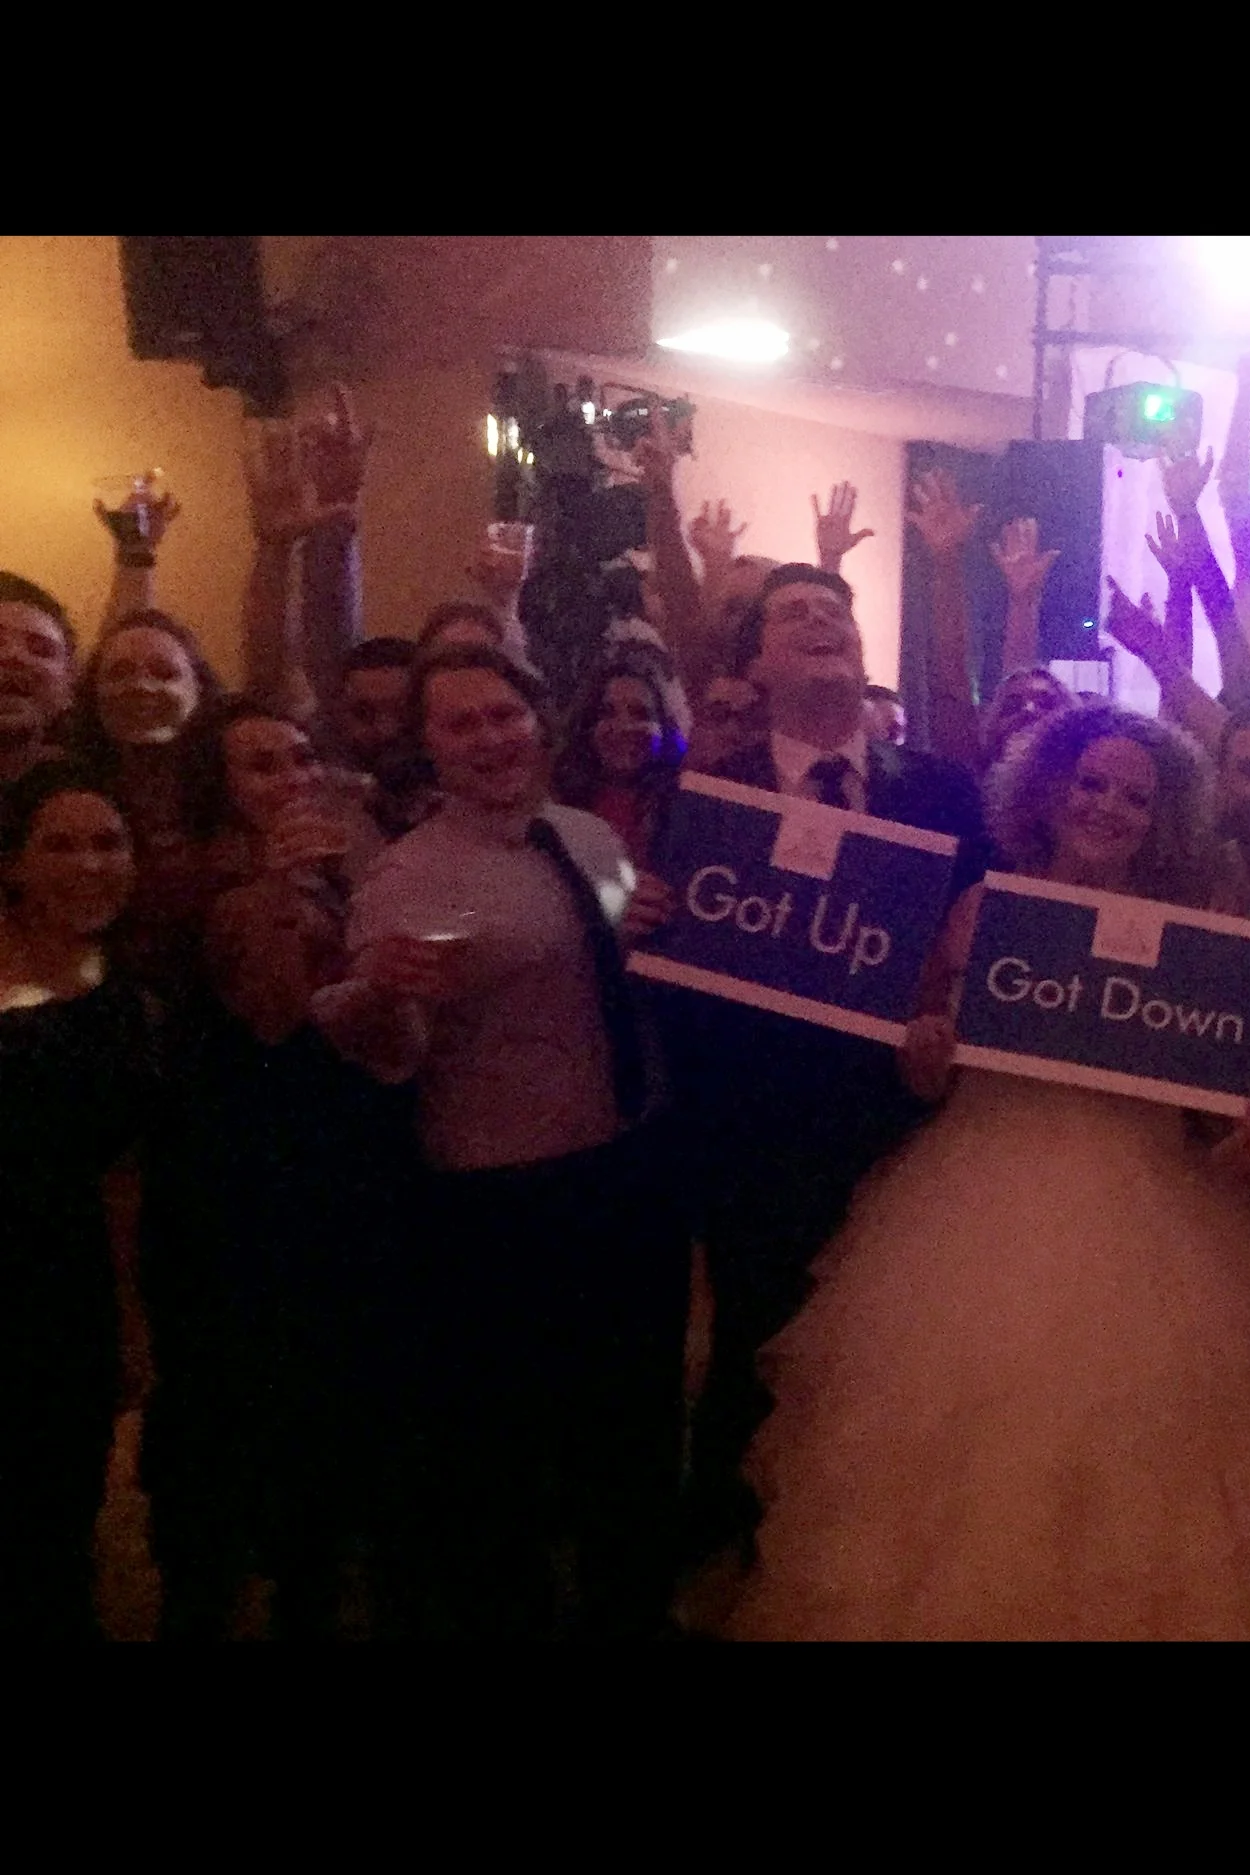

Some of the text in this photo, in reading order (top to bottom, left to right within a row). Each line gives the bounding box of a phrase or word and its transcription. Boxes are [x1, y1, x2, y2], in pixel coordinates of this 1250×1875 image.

[688, 865, 892, 974] Got Up
[987, 957, 1244, 1044] Got Down
